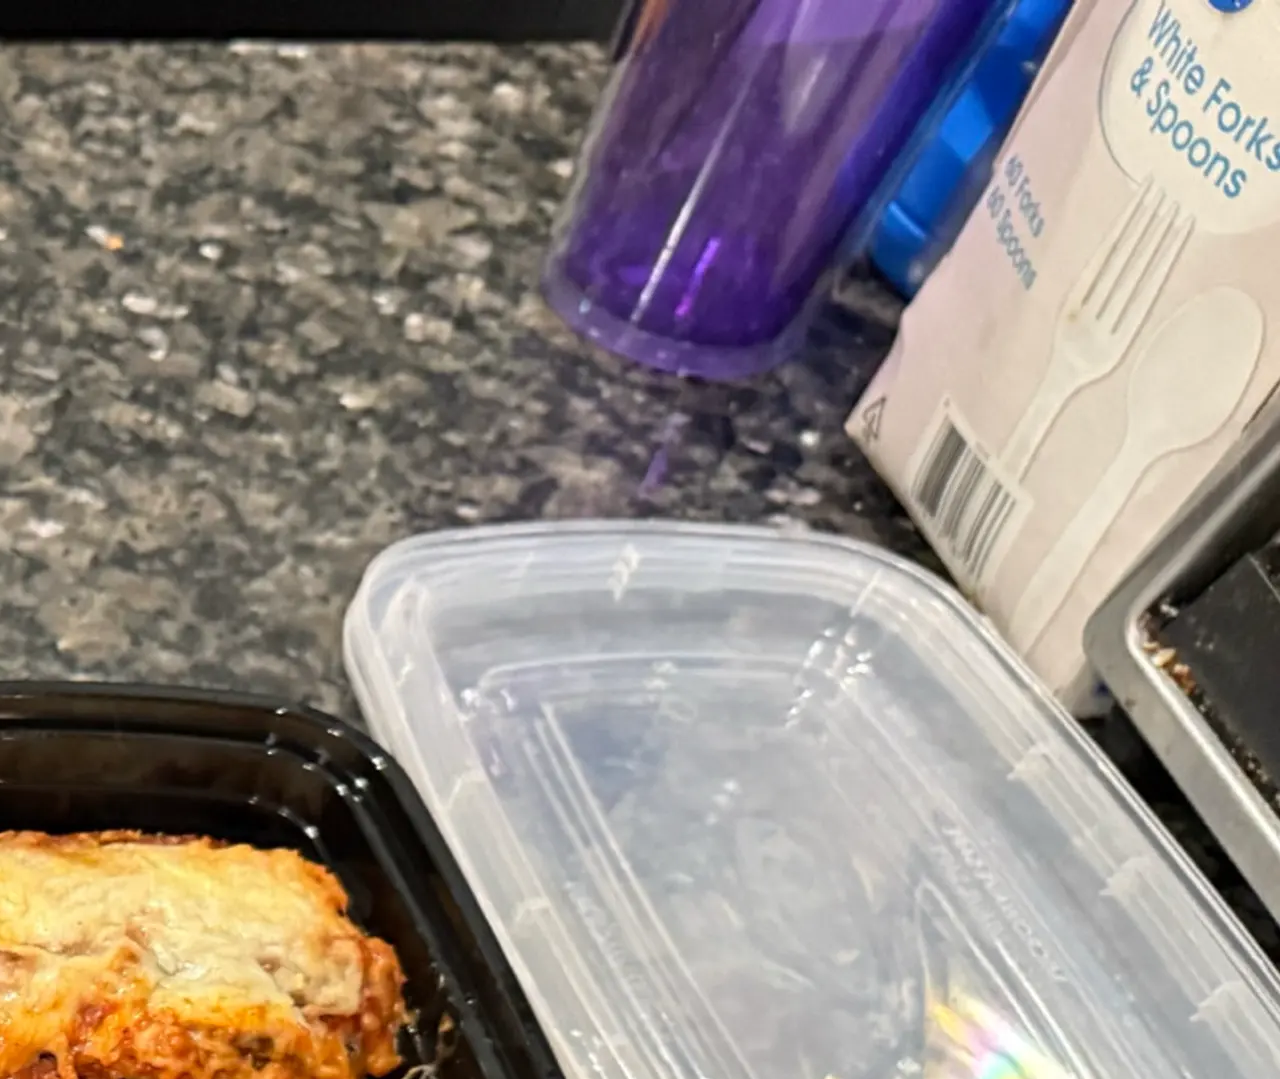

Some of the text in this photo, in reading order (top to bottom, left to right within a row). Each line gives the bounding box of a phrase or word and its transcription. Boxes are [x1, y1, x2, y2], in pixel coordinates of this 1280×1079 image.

[1147, 0, 1205, 95] White
[1130, 56, 1247, 198] & Spoons
[996, 208, 1037, 291] Spoons
